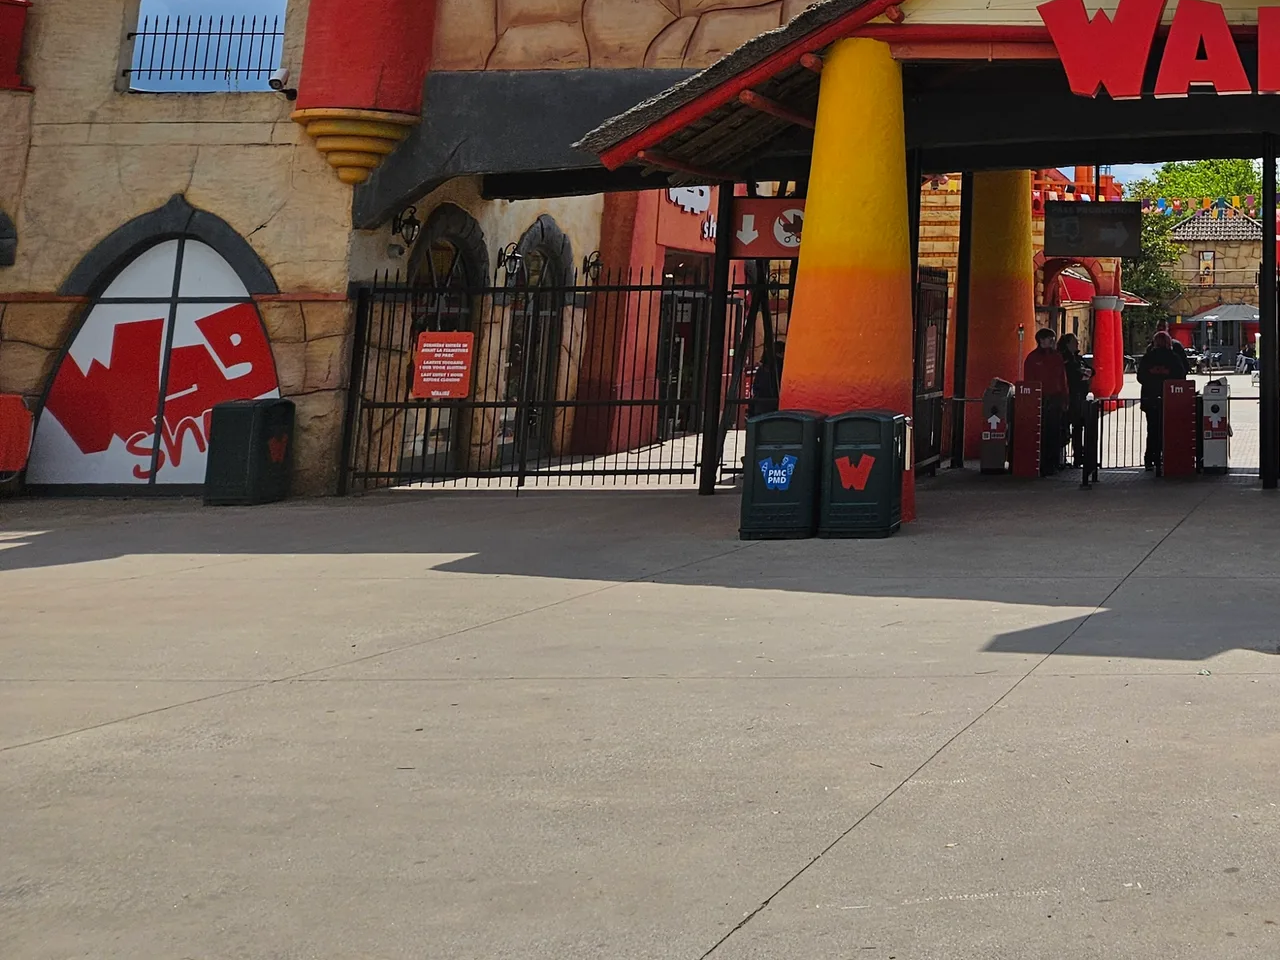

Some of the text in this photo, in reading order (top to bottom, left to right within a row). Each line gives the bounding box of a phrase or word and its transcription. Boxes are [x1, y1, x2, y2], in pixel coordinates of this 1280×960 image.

[1020, 385, 1031, 394] 1m
[1170, 385, 1183, 394] 1m
[125, 408, 213, 479] sh
[768, 469, 787, 477] PMC
